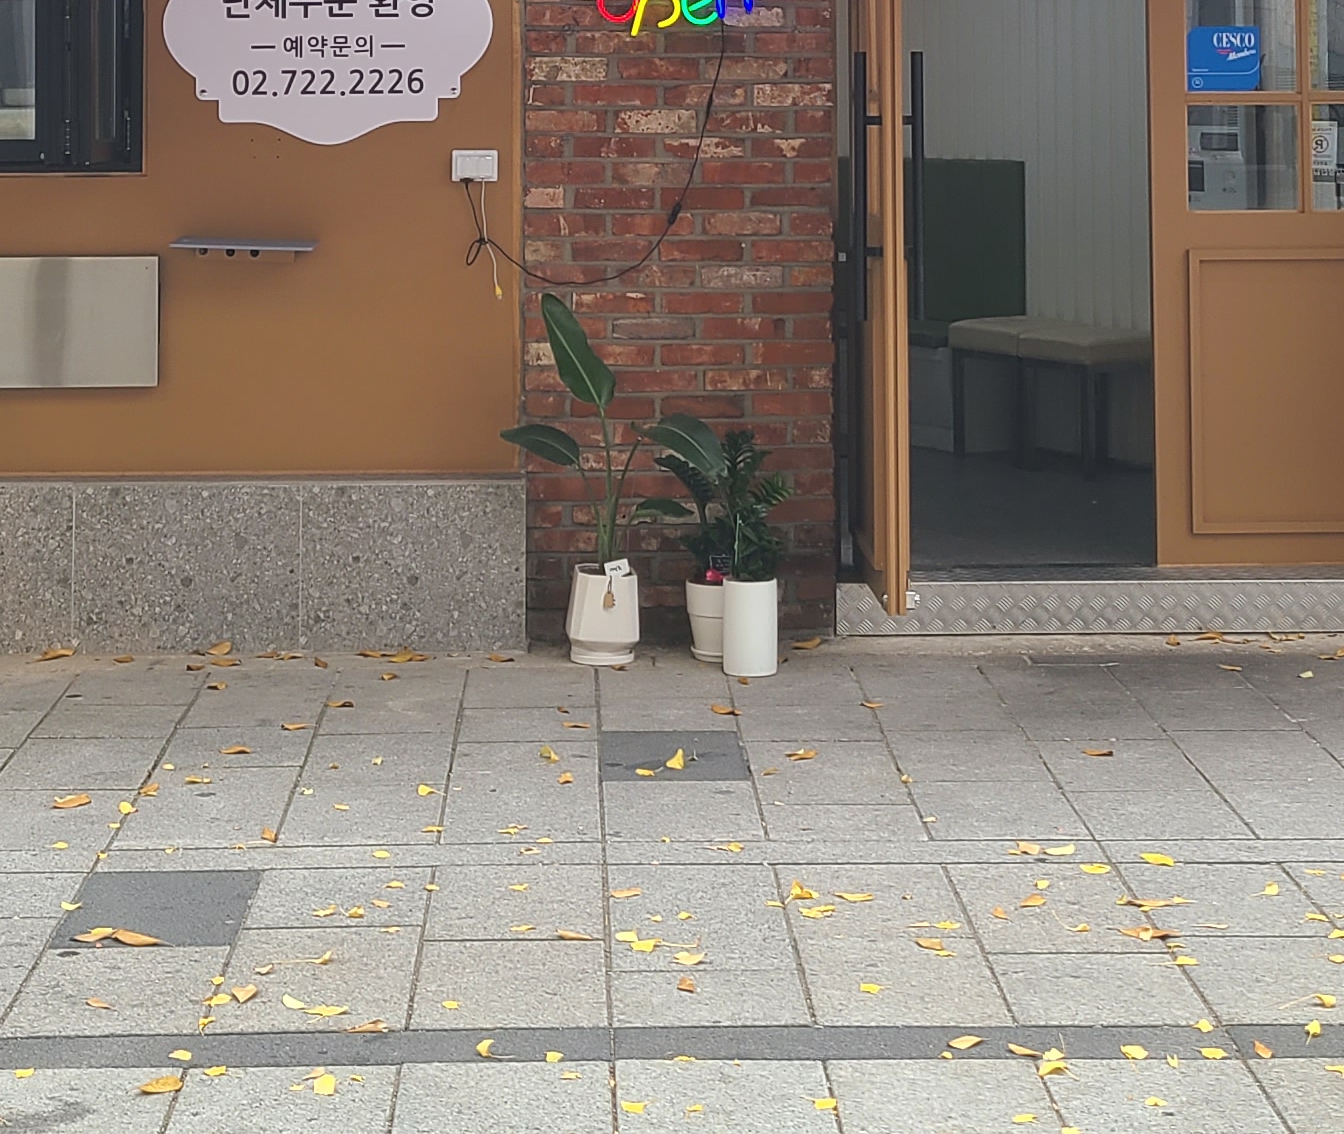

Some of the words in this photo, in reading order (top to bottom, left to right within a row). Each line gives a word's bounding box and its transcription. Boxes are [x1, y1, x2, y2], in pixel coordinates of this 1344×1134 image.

[282, 35, 375, 58] 예약문의
[1213, 32, 1255, 48] CESCO
[232, 68, 425, 98] 02.722.2226
